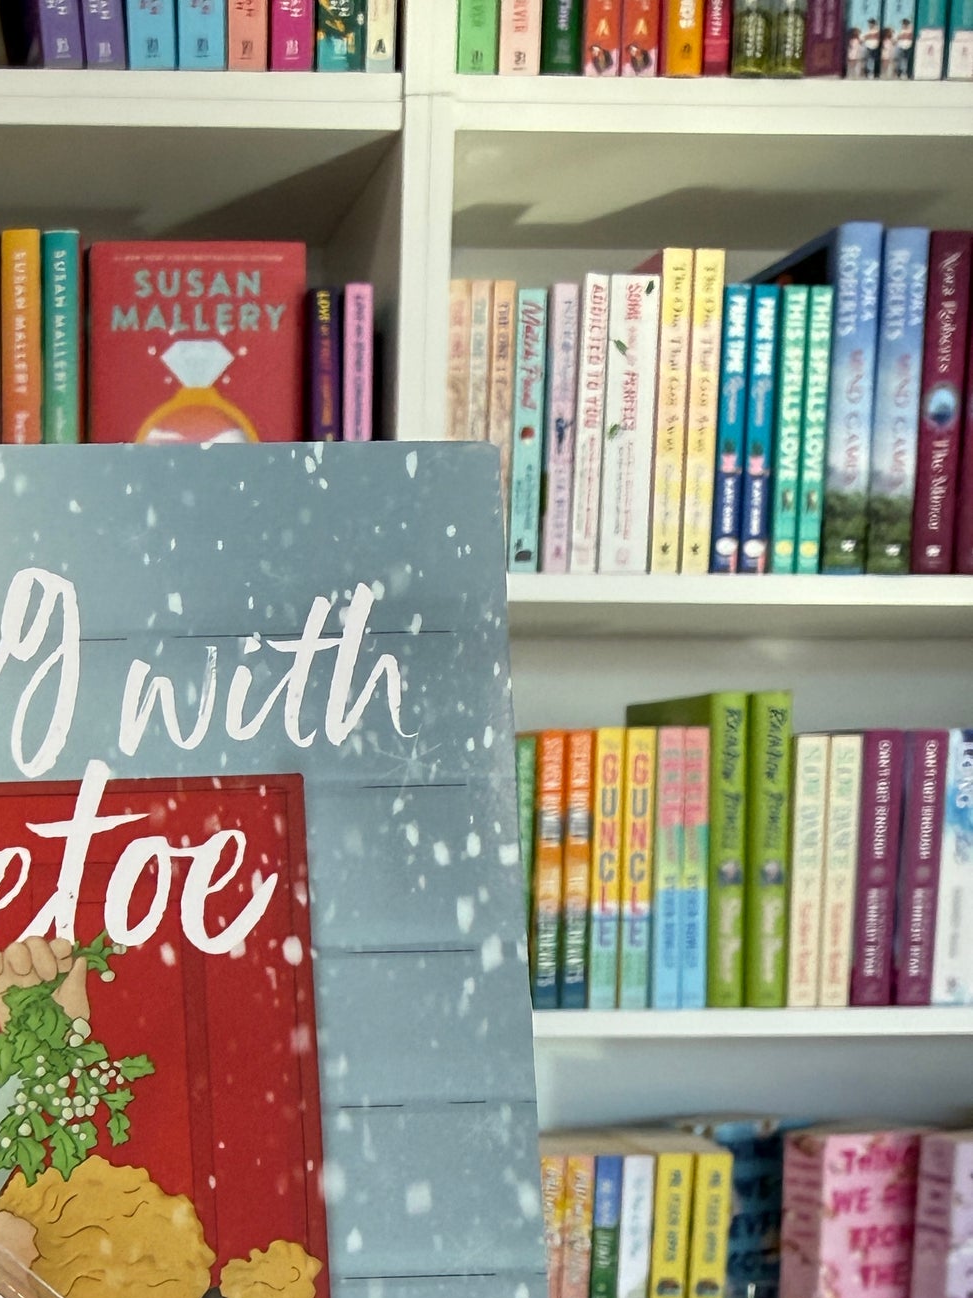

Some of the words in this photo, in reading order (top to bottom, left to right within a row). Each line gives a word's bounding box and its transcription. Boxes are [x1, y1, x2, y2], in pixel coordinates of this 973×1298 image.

[13, 250, 27, 310] SUSAN
[53, 249, 68, 308] SUSAN
[134, 268, 261, 297] SUSAN
[838, 244, 861, 337] ROBERTS
[861, 260, 879, 322] NORA
[885, 249, 909, 341] ROBERTS
[909, 263, 927, 327] NORA
[111, 302, 286, 332] MALLERY
[587, 284, 606, 365] ADDICTED
[787, 293, 806, 341] THIS
[813, 294, 831, 342] THIS
[14, 316, 29, 395] MALLERY
[53, 314, 68, 393] MALLERY
[586, 371, 603, 390] TO
[782, 347, 801, 421] SPELLS
[807, 348, 828, 422] SPELLS
[584, 397, 601, 429] YOU
[778, 426, 797, 482] LOVE
[804, 427, 824, 482] LOVE
[116, 580, 419, 760] with
[598, 753, 619, 947] GUNCLE
[629, 753, 650, 947] GUNCLE
